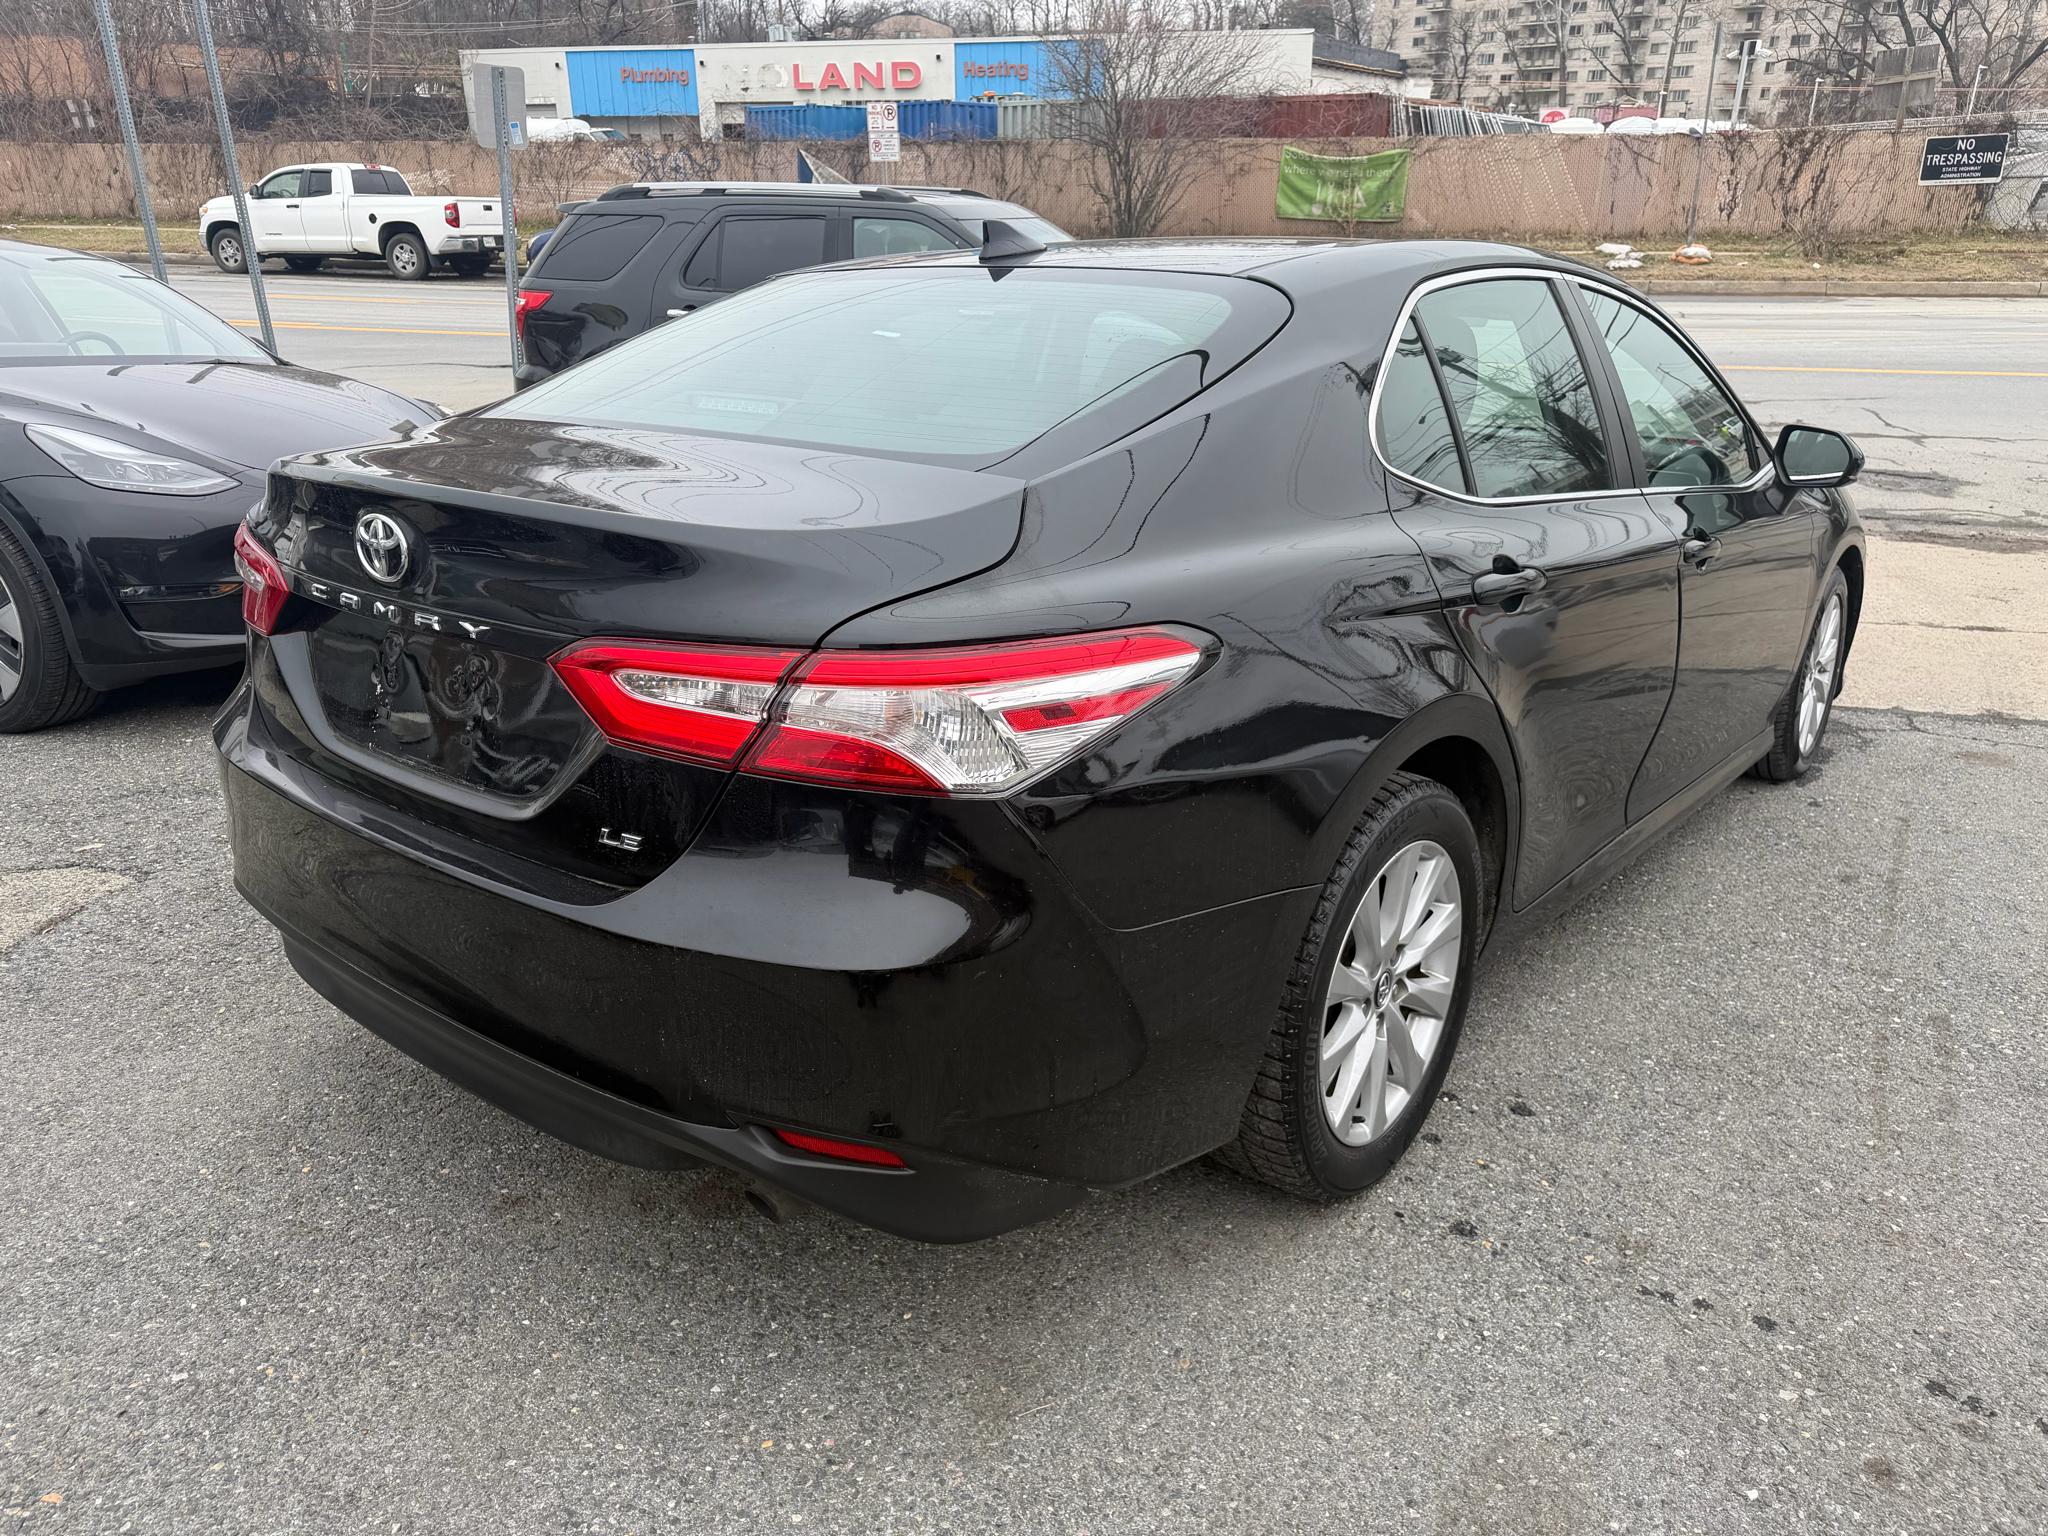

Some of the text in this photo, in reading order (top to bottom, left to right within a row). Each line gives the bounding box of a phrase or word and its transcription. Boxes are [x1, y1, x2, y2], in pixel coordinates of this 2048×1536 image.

[621, 66, 688, 86] Plumbing
[963, 61, 1029, 81] Heating
[1956, 138, 1976, 151] NO
[1926, 151, 2003, 166] TRESPASSING
[1284, 163, 1316, 176] where
[311, 583, 490, 639] CAMRY
[598, 827, 642, 851] LE
